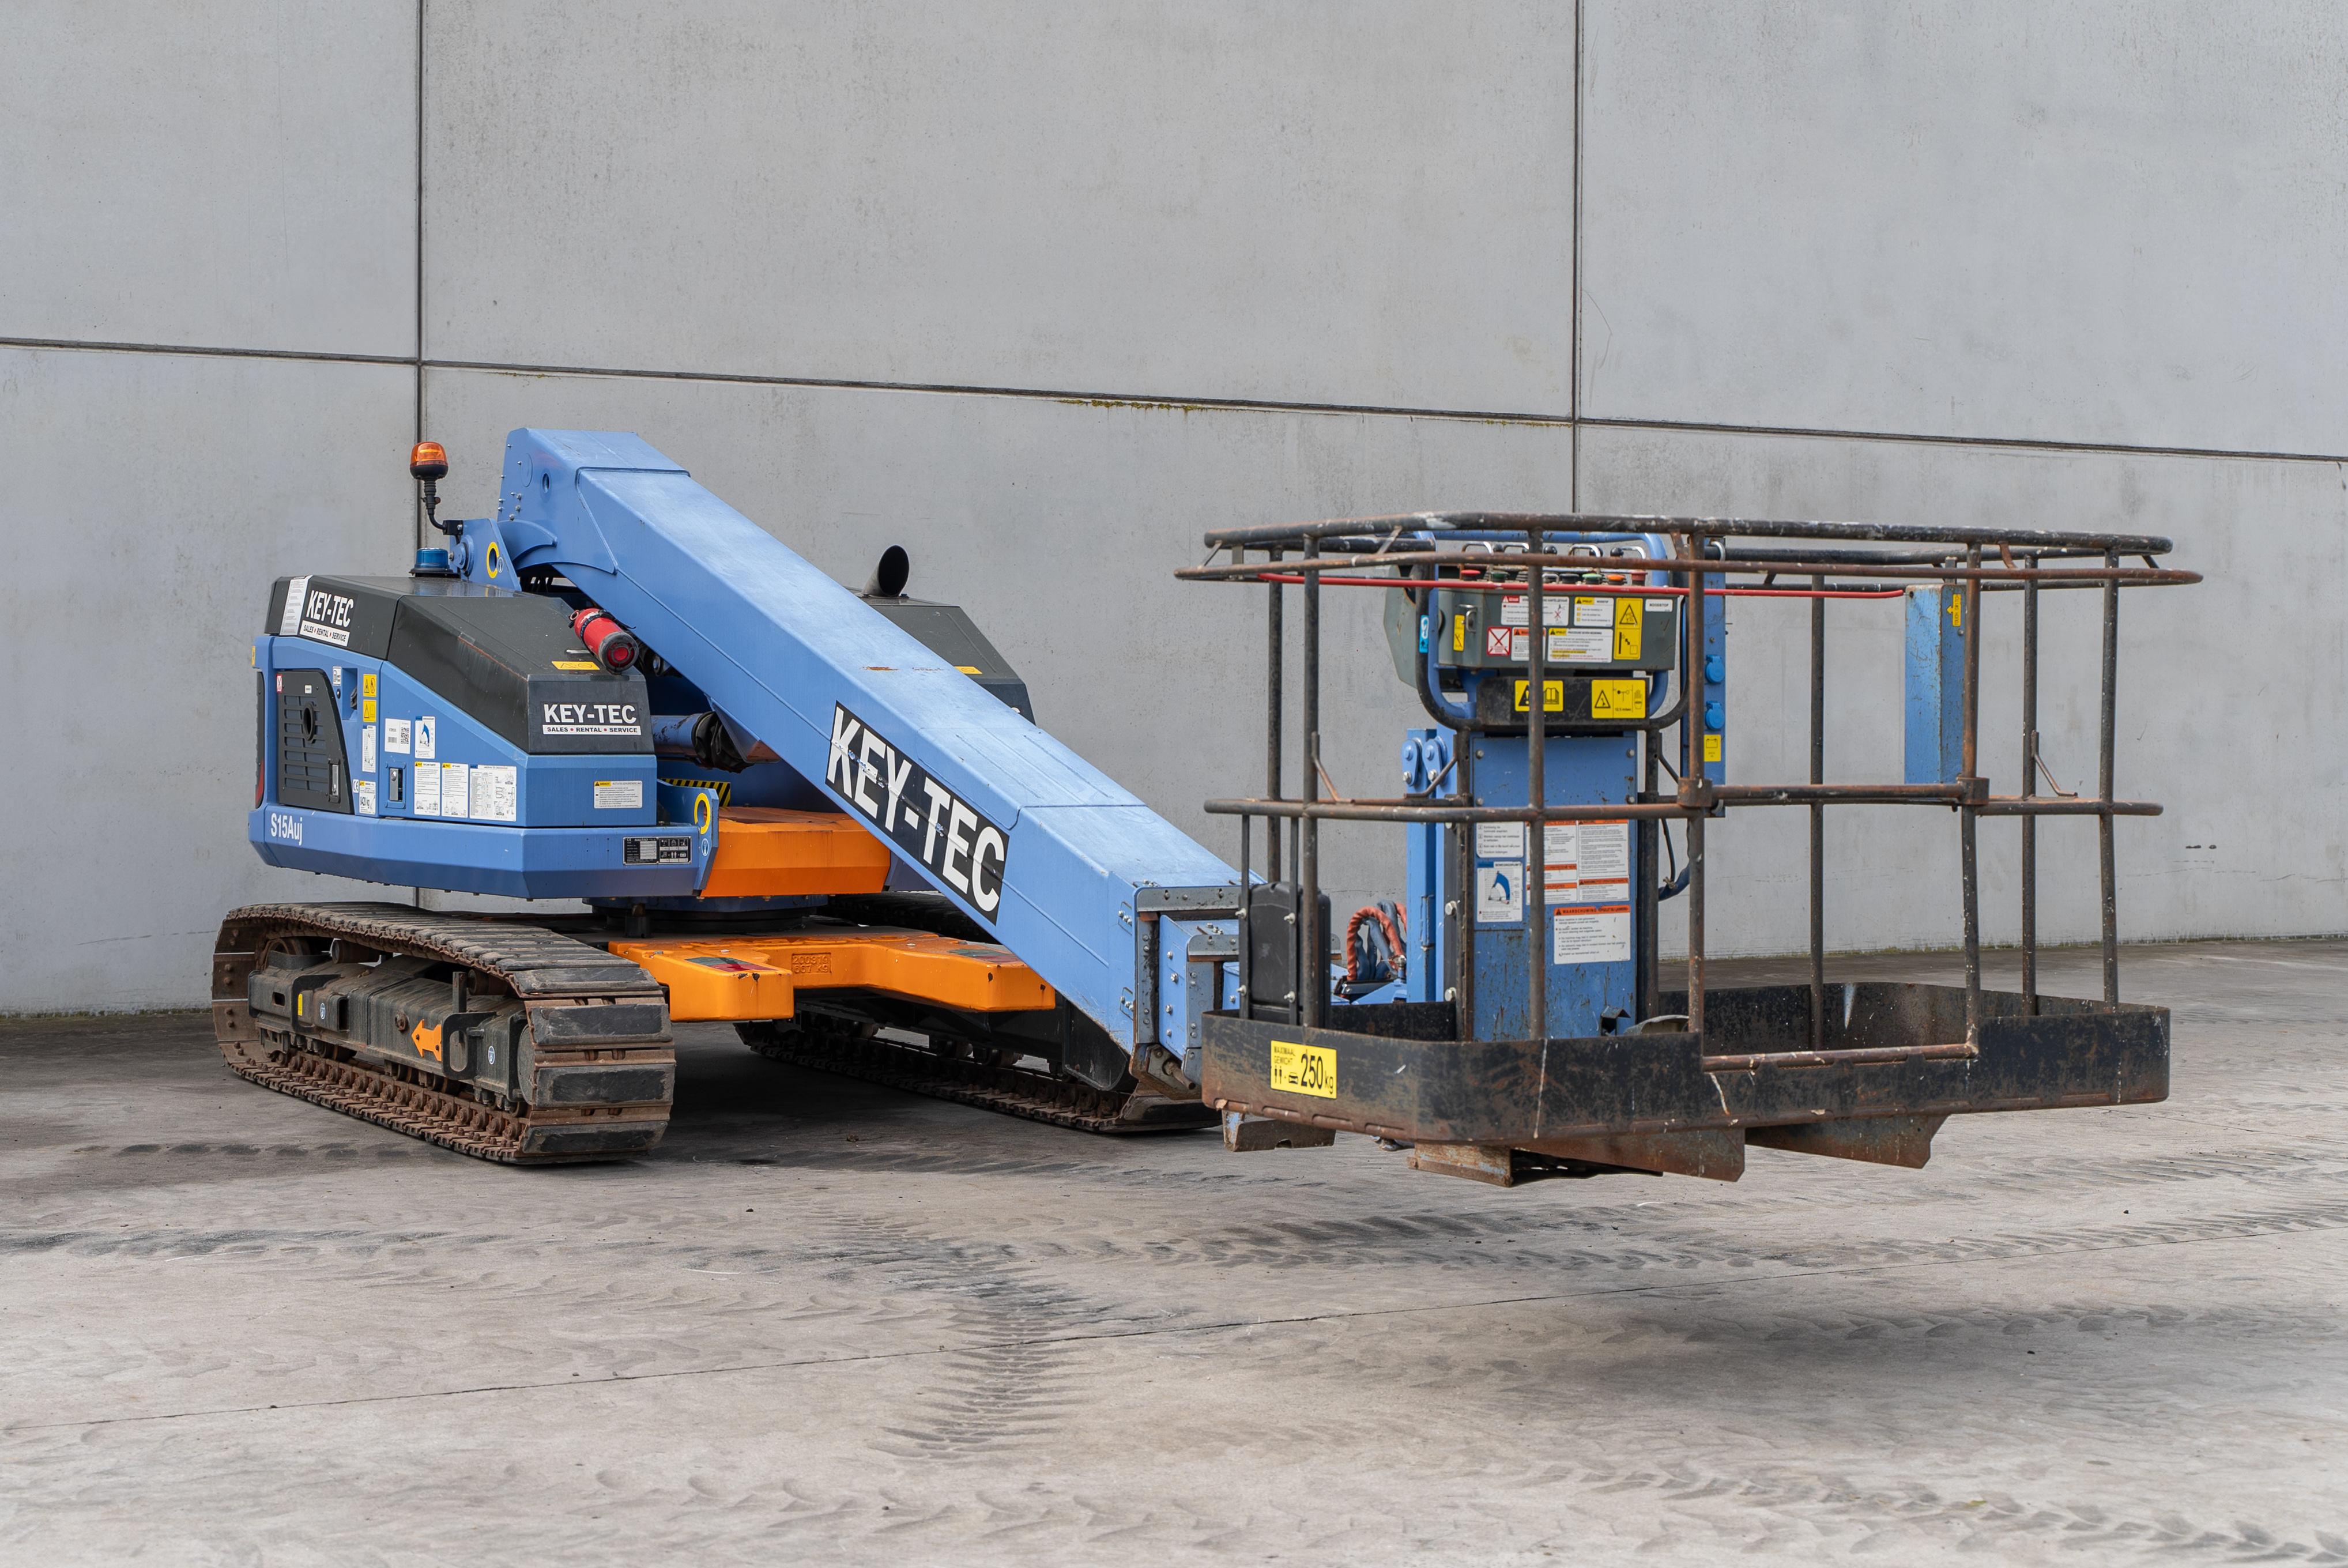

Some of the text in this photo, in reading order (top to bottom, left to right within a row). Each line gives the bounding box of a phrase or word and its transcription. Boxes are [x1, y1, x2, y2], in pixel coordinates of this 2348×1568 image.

[306, 590, 354, 628] KEY-TEC
[303, 624, 346, 642] SALES RENTAL SERVICE
[544, 704, 637, 724] KEY-TEC
[827, 706, 1005, 911] KEY-TEC
[270, 812, 303, 846] S15Auj
[794, 964, 812, 974] 667
[1274, 1056, 1293, 1065] GEWICHT
[1301, 1053, 1334, 1095] 250 kg
